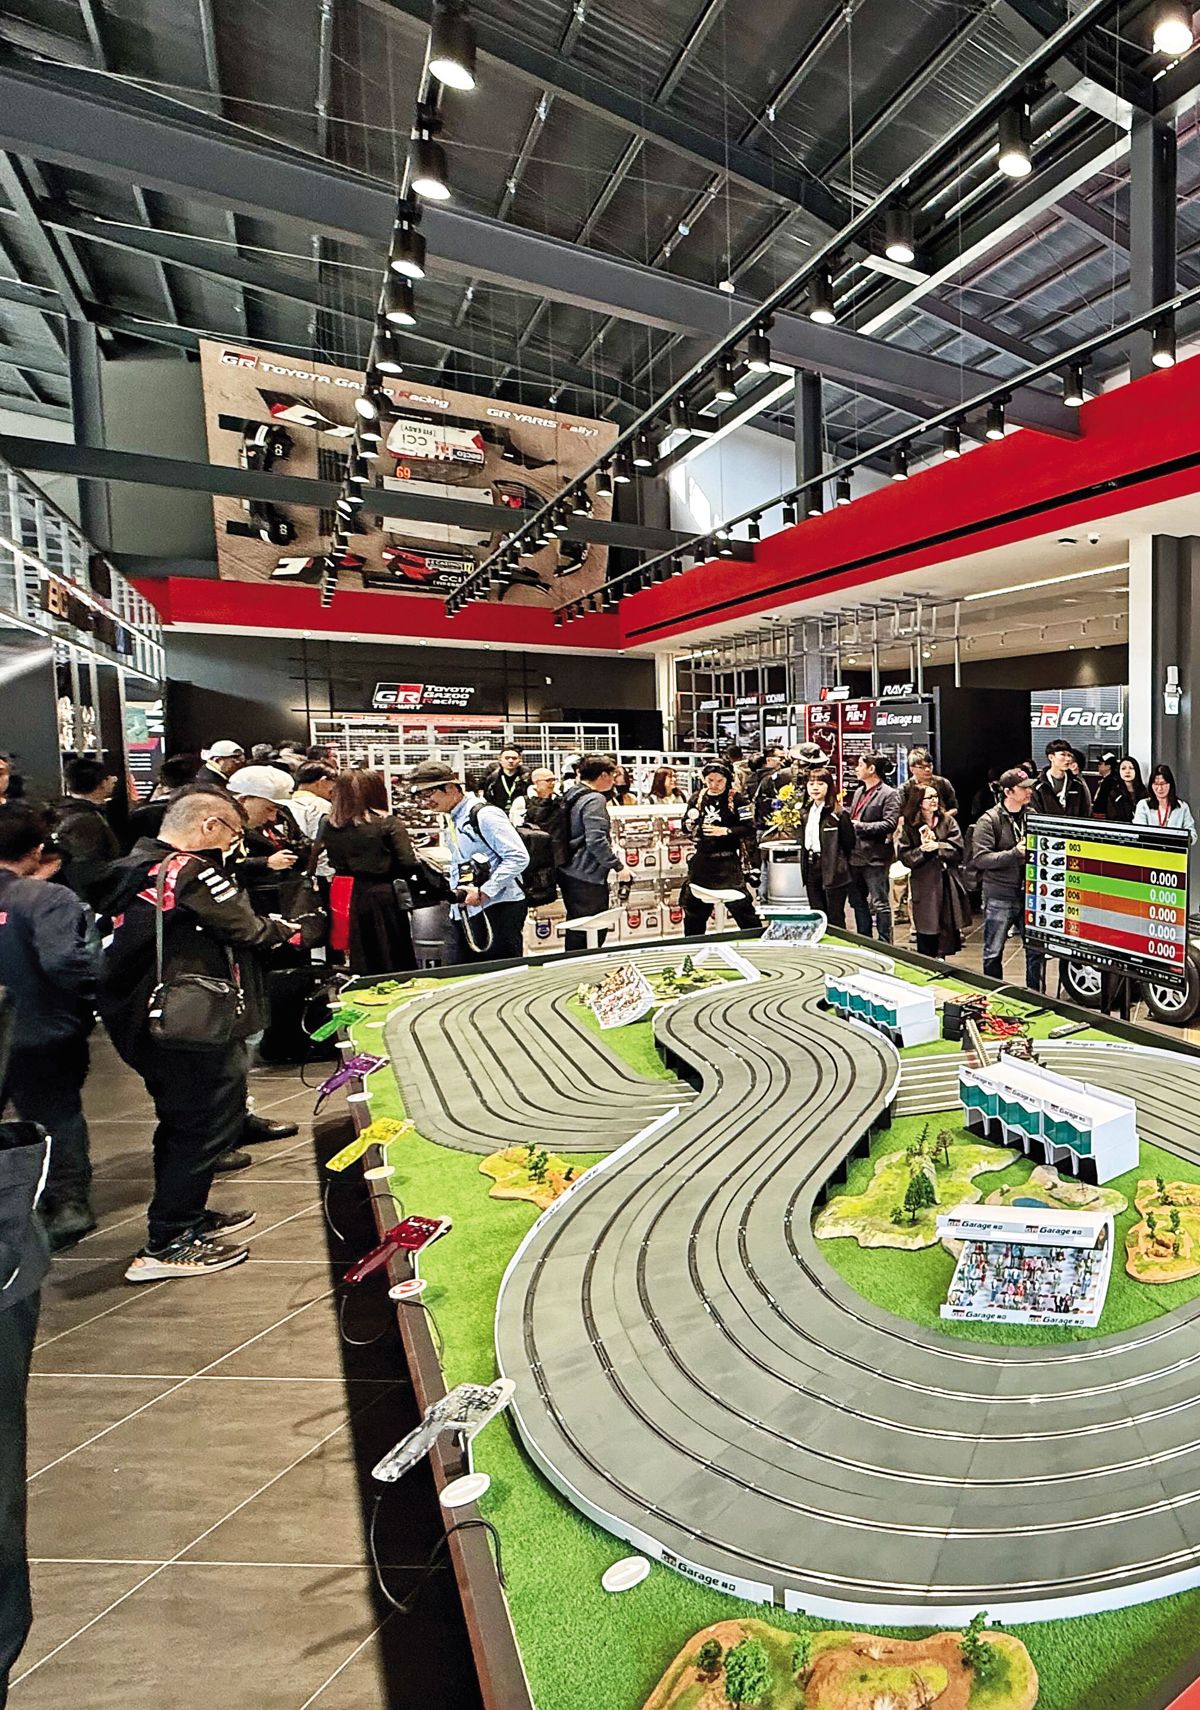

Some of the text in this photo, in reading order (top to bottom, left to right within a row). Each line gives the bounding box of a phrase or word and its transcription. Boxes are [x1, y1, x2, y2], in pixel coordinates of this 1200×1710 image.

[222, 354, 449, 409] GR TOYOTA GAO Racing
[486, 408, 510, 420] GR
[514, 414, 558, 428] YARIS
[396, 466, 410, 479] 69
[425, 684, 475, 694] TOYOTA
[882, 684, 914, 696] RAYS
[376, 690, 420, 704] GR
[422, 698, 468, 707] Racing
[424, 692, 470, 700] GAZOO
[888, 714, 912, 727] Garage
[1060, 708, 1124, 730] Garag
[1069, 842, 1082, 852] 003
[1029, 854, 1035, 862] 2
[1150, 870, 1178, 888] 0.000
[1028, 868, 1177, 906] 3 005 0.000
[1068, 890, 1080, 900] 006
[1149, 906, 1176, 924] 0.000
[1028, 898, 1176, 940] 5 001 0.000
[1028, 914, 1034, 923] 6
[1148, 940, 1176, 958] 0.000
[961, 1220, 992, 1230] Garage
[1040, 1227, 1071, 1236] Garage
[966, 1311, 996, 1320] Garage
[1042, 1316, 1072, 1325] Garage
[678, 1562, 719, 1585] Garage
